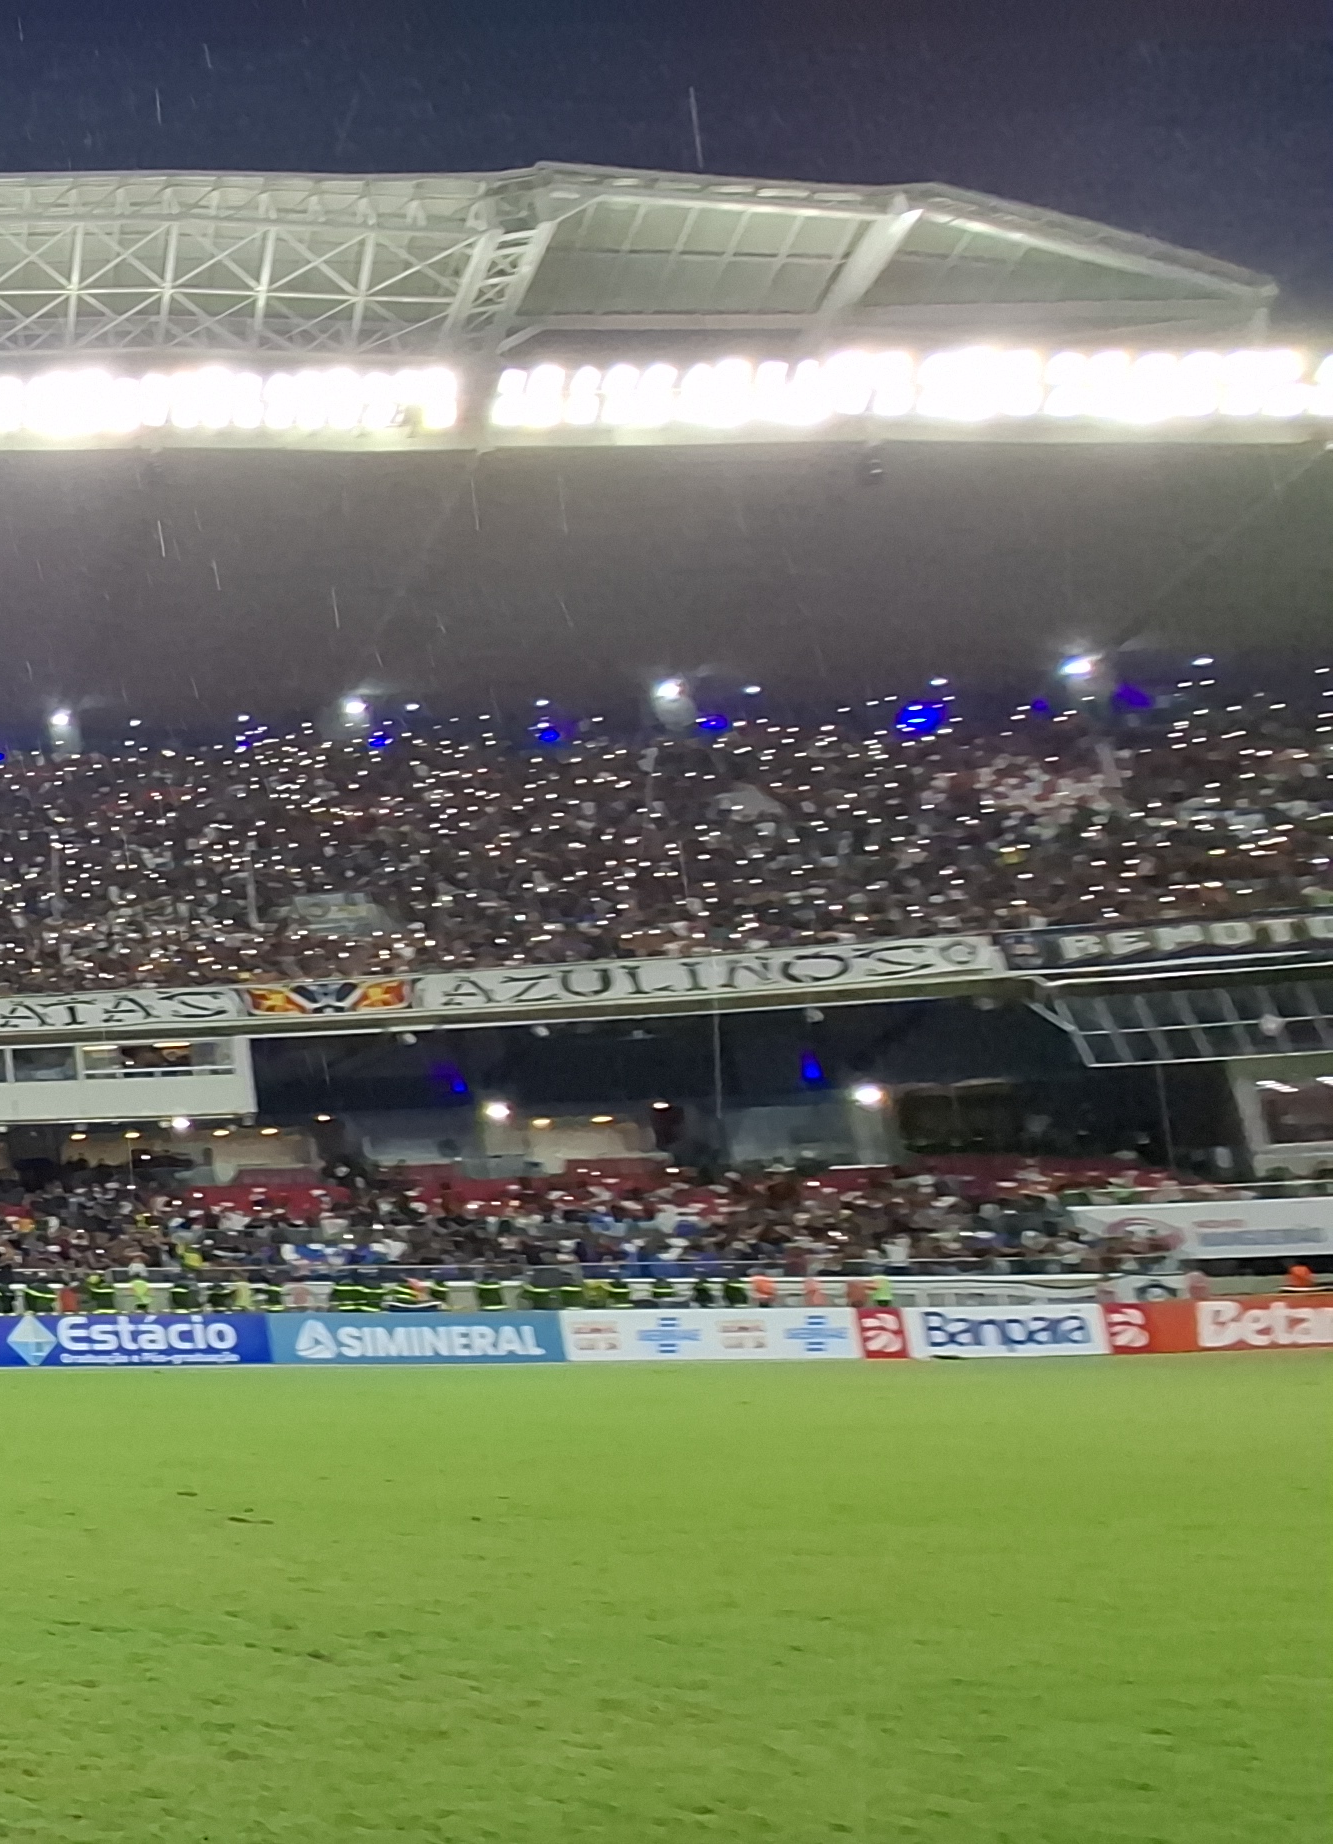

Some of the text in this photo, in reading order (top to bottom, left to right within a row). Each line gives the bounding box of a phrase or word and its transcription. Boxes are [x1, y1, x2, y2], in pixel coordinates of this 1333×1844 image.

[441, 944, 935, 1006] AZULINOS
[56, 1315, 238, 1350] Estácio
[336, 1326, 547, 1357] SIMINERAL
